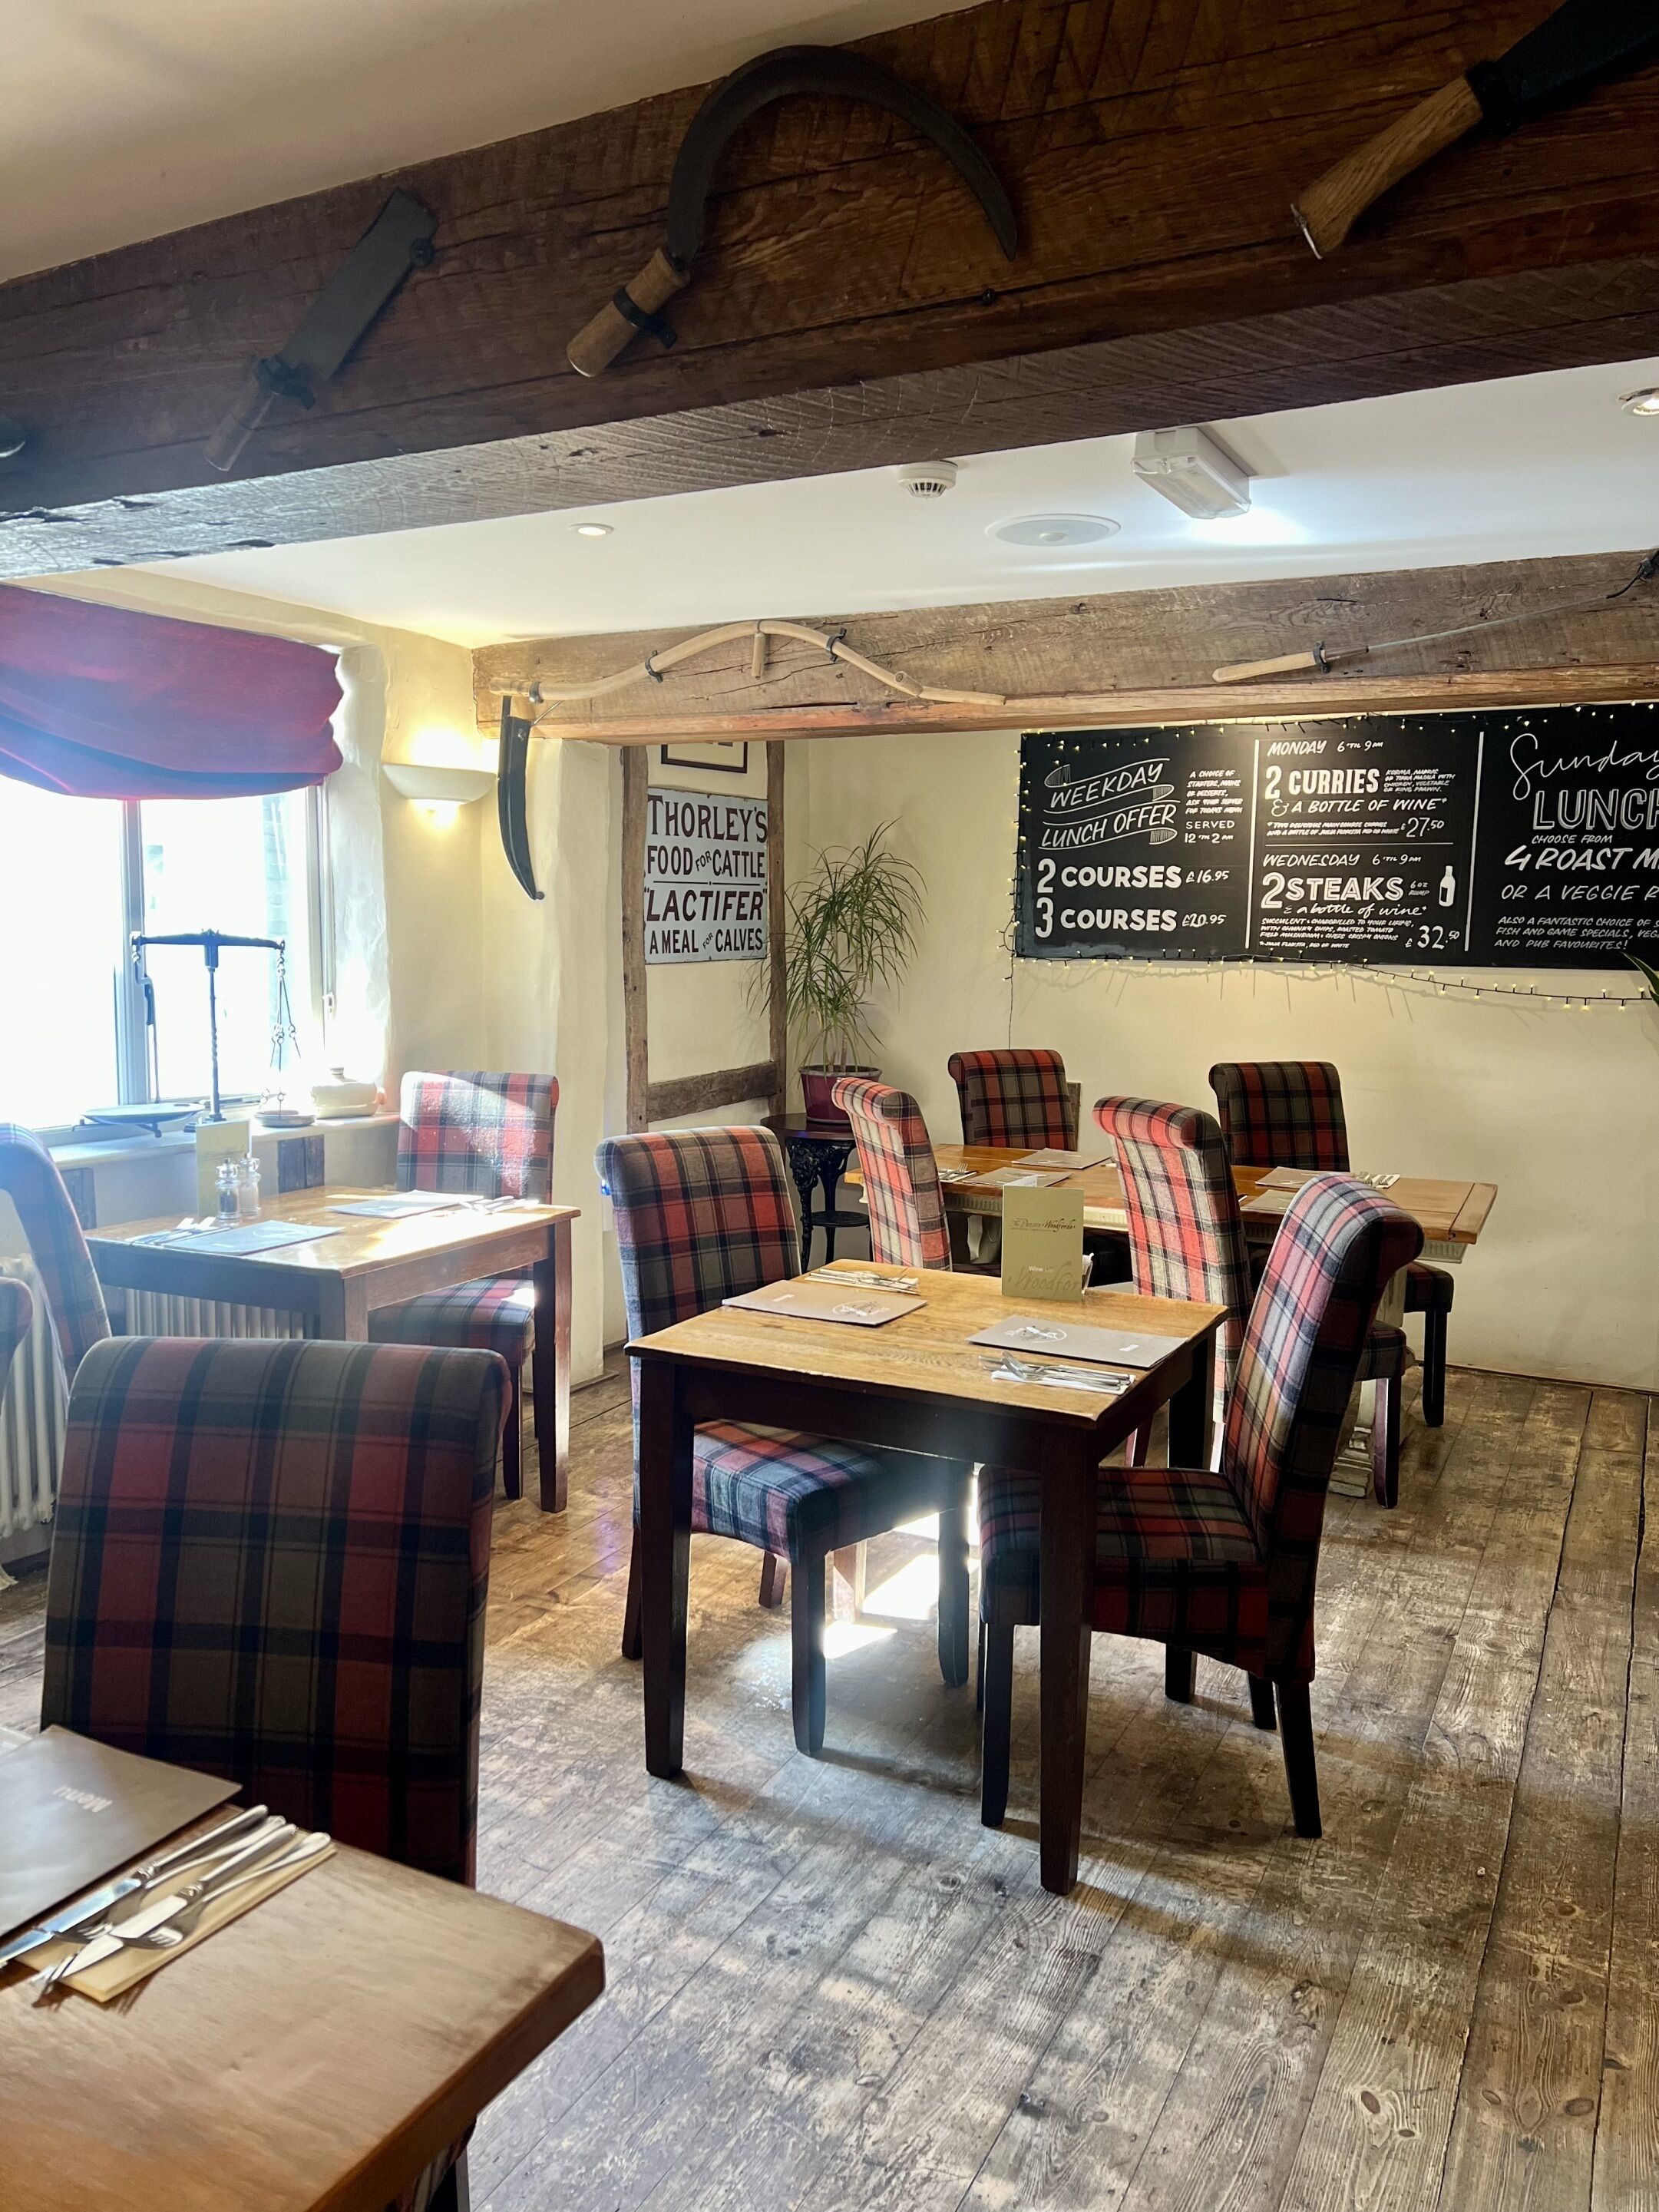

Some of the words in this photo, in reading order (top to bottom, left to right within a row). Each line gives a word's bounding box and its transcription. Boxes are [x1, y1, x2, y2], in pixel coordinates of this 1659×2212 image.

[1267, 740, 1327, 756] MONDAY
[1337, 741, 1345, 752] 6
[1050, 763, 1163, 808] WEEKDAY
[1265, 765, 1281, 799] 2
[1289, 769, 1380, 795] CURRIES
[647, 794, 768, 843] THORLEY'S
[1271, 799, 1289, 816] &
[1291, 800, 1302, 812] A
[1308, 799, 1364, 813] BOTTLE
[1368, 799, 1389, 812] OF
[1041, 818, 1108, 847] LUNCH
[1113, 804, 1177, 833] OFFER
[1185, 820, 1234, 829] SERVED
[1401, 817, 1444, 837] £27.50
[1185, 832, 1196, 843] 12
[1532, 835, 1577, 844] CHOOSE
[1581, 835, 1612, 844] FROM
[647, 845, 693, 875] FOOD
[695, 851, 712, 871] FOR
[712, 849, 765, 878] CATTLE
[1263, 854, 1360, 867] WEDNESDAY
[1372, 854, 1380, 865] 6
[1505, 845, 1532, 871] 4
[1535, 848, 1633, 870] ROAST
[1632, 848, 1659, 870] M
[1037, 858, 1056, 893] 2
[1061, 865, 1181, 888] COURSES
[1185, 869, 1229, 884] £16.95
[1261, 871, 1285, 909] 2
[1285, 877, 1404, 901] STEAKS
[1501, 884, 1528, 900] OR
[1535, 885, 1550, 900] A
[1562, 885, 1640, 901] VEGGIE
[1036, 897, 1054, 937] 3
[1060, 908, 1178, 931] COURSES
[1182, 913, 1226, 928] £20.95
[1310, 903, 1353, 914] bottle
[1357, 902, 1375, 918] of
[1498, 916, 1525, 924] ALSO
[1537, 917, 1594, 925] FANTASTIC
[649, 930, 659, 954] A
[662, 929, 699, 954] MEAL
[702, 932, 714, 950] FOR
[715, 927, 763, 952] CALVES
[1405, 924, 1459, 950] £32.50
[1496, 927, 1521, 935] FISH
[1522, 927, 1545, 936] AND
[1580, 928, 1634, 939] SPECIALS,
[1638, 929, 1659, 938] VEG
[1495, 939, 1520, 947] AND
[1553, 939, 1628, 951] FAVOURITES!
[51, 1785, 113, 1813] Menu
